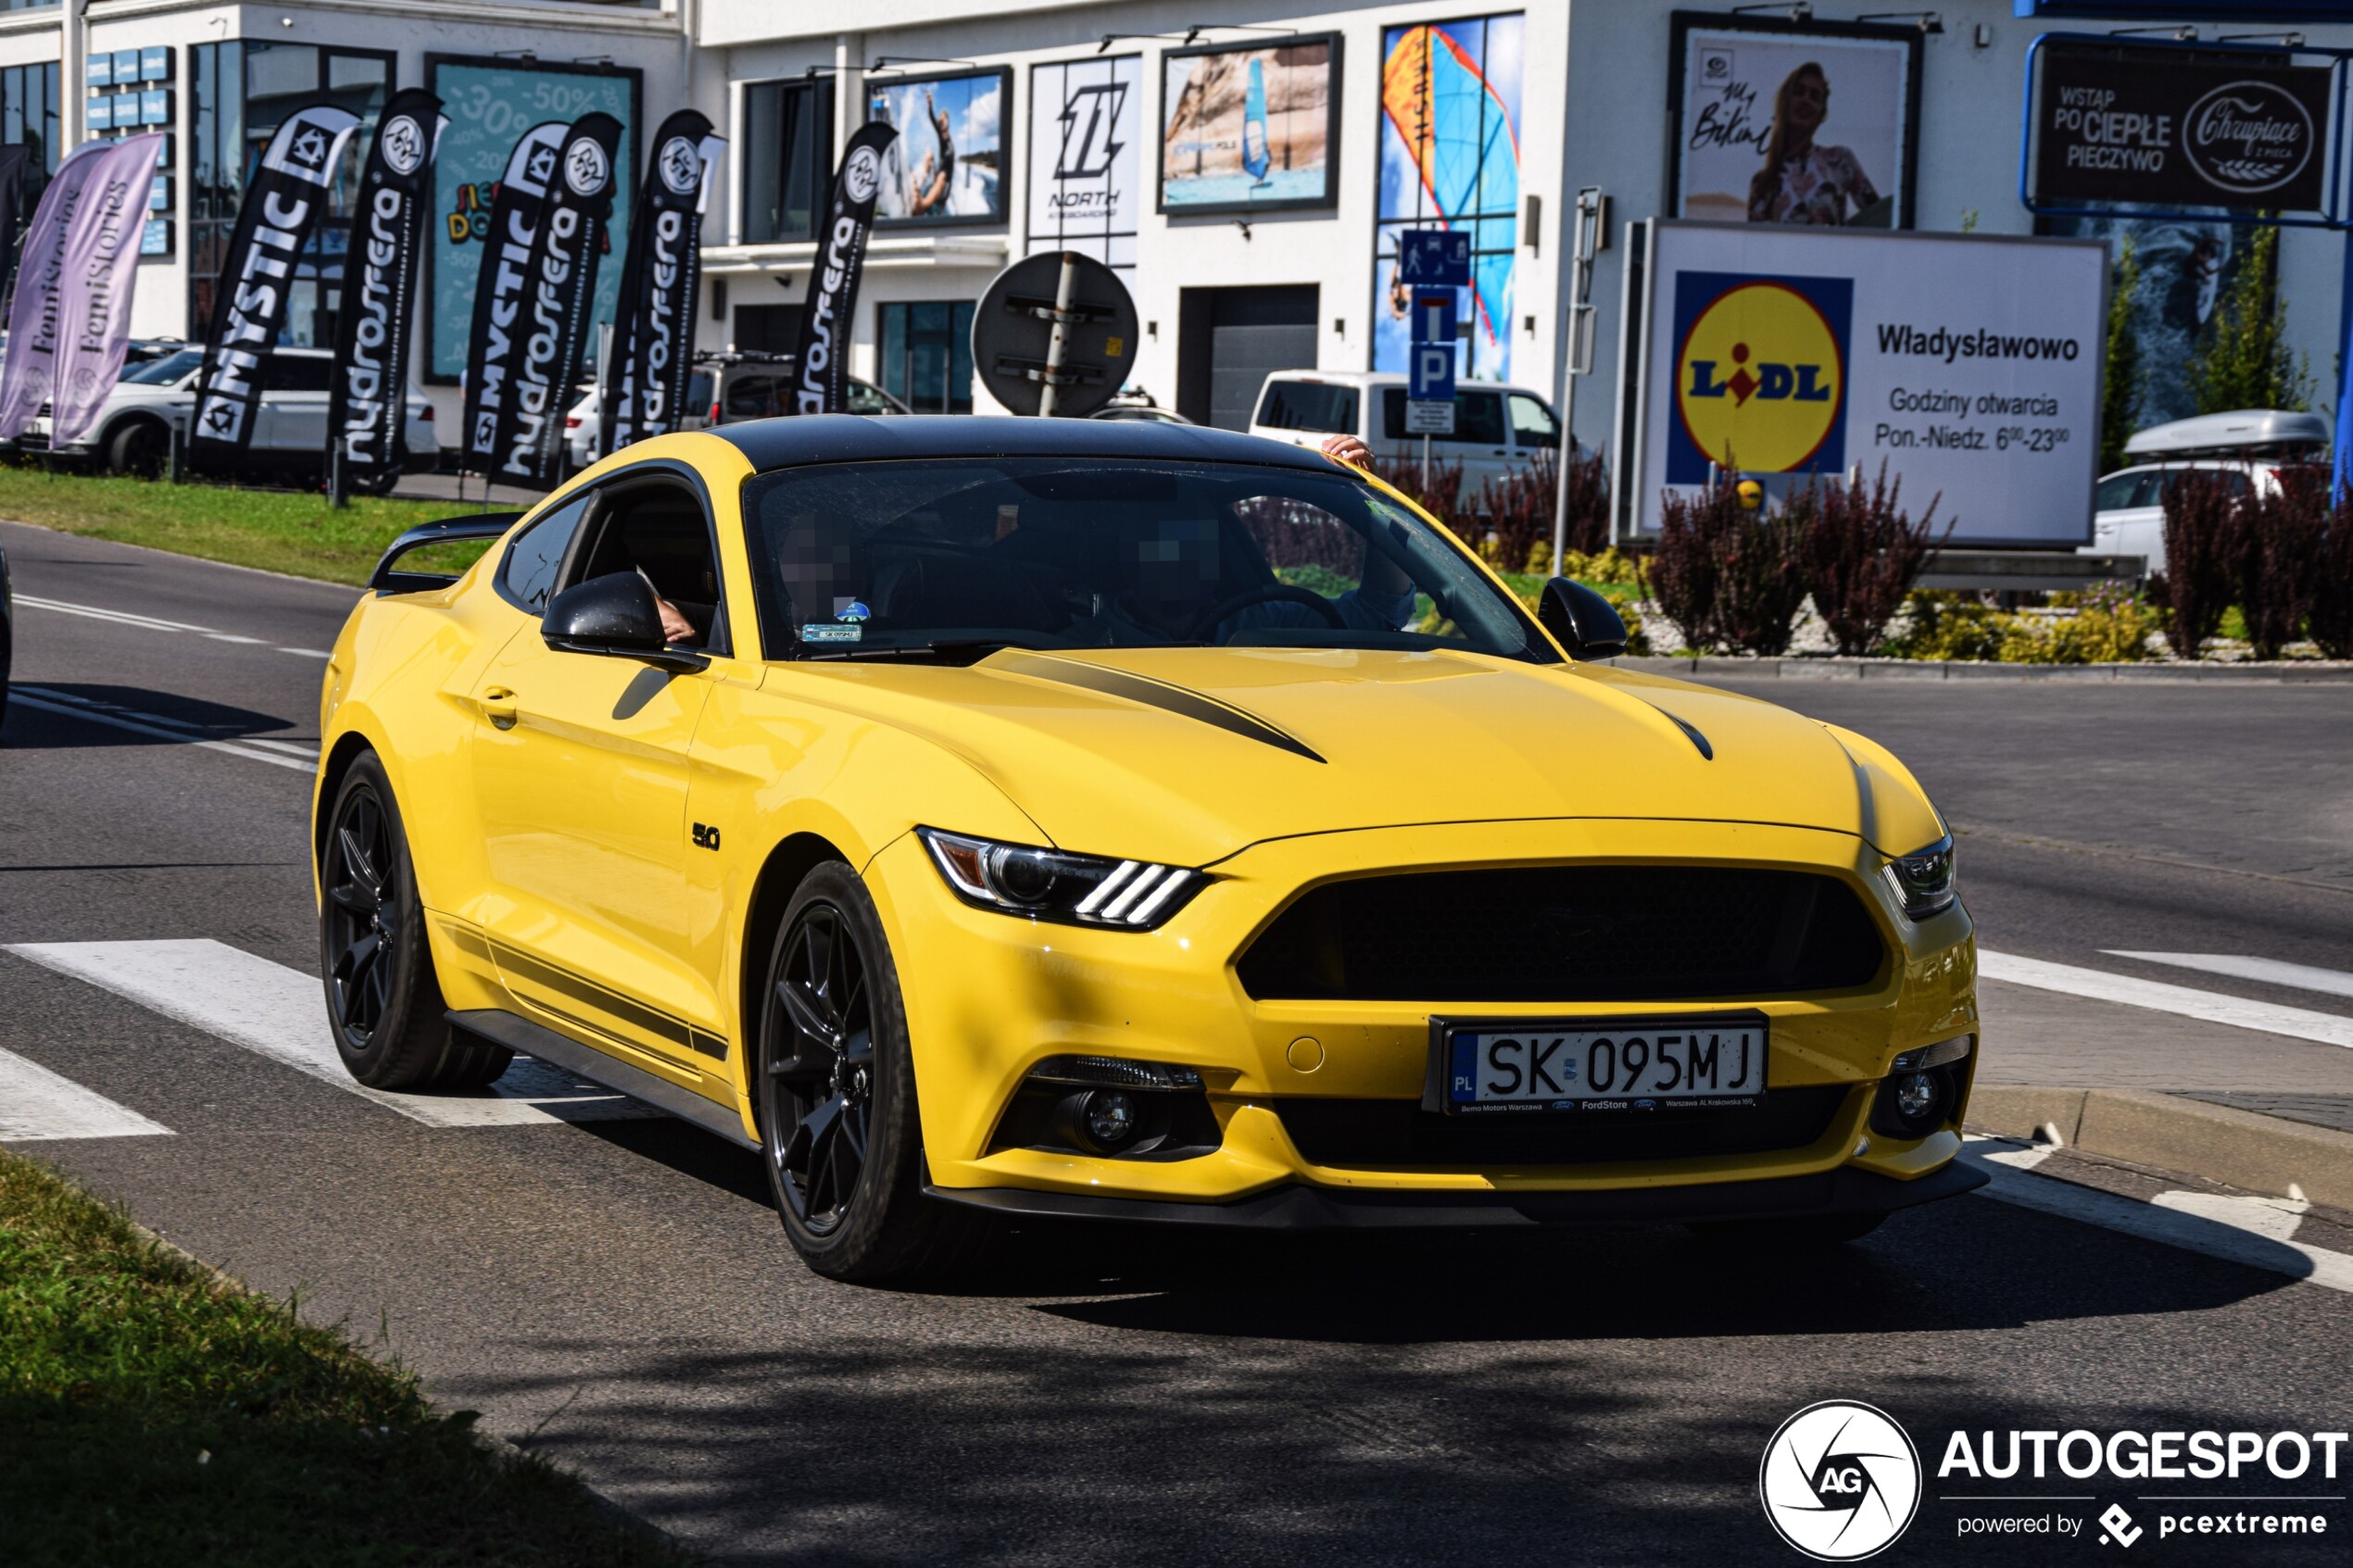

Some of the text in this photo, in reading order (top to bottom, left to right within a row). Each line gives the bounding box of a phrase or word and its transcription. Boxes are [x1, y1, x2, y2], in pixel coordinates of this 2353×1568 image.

[522, 81, 596, 115] -50%
[1723, 82, 1757, 111] My
[2060, 87, 2116, 111] WSTĄP
[1689, 101, 1777, 156] Bikini
[2054, 107, 2172, 147] PO CIEPŁE
[2196, 96, 2302, 157] Chrupiące
[2067, 144, 2165, 172] PIECZYWO
[1049, 190, 1121, 207] NORTH
[80, 180, 127, 354] FemiStories
[208, 191, 308, 396] MYSTIC
[570, 274, 586, 333] WAKEBOARD
[680, 276, 694, 336] WAKEBOARD
[502, 207, 578, 476] hydrosfera
[1878, 323, 2080, 363] Władysławowo
[1420, 350, 1447, 393] P
[1889, 387, 2058, 419] Godziny otwarcia
[1875, 423, 1989, 450] Pon.-Niedz.
[1488, 1033, 1749, 1095] SK 095MJ
[1454, 1076, 1473, 1092] PL
[1508, 1103, 1542, 1111] Warszawa
[1581, 1099, 1628, 1110] FordStore
[1667, 1099, 1698, 1108] Warszawa
[1707, 1098, 1742, 1107] Krakowska
